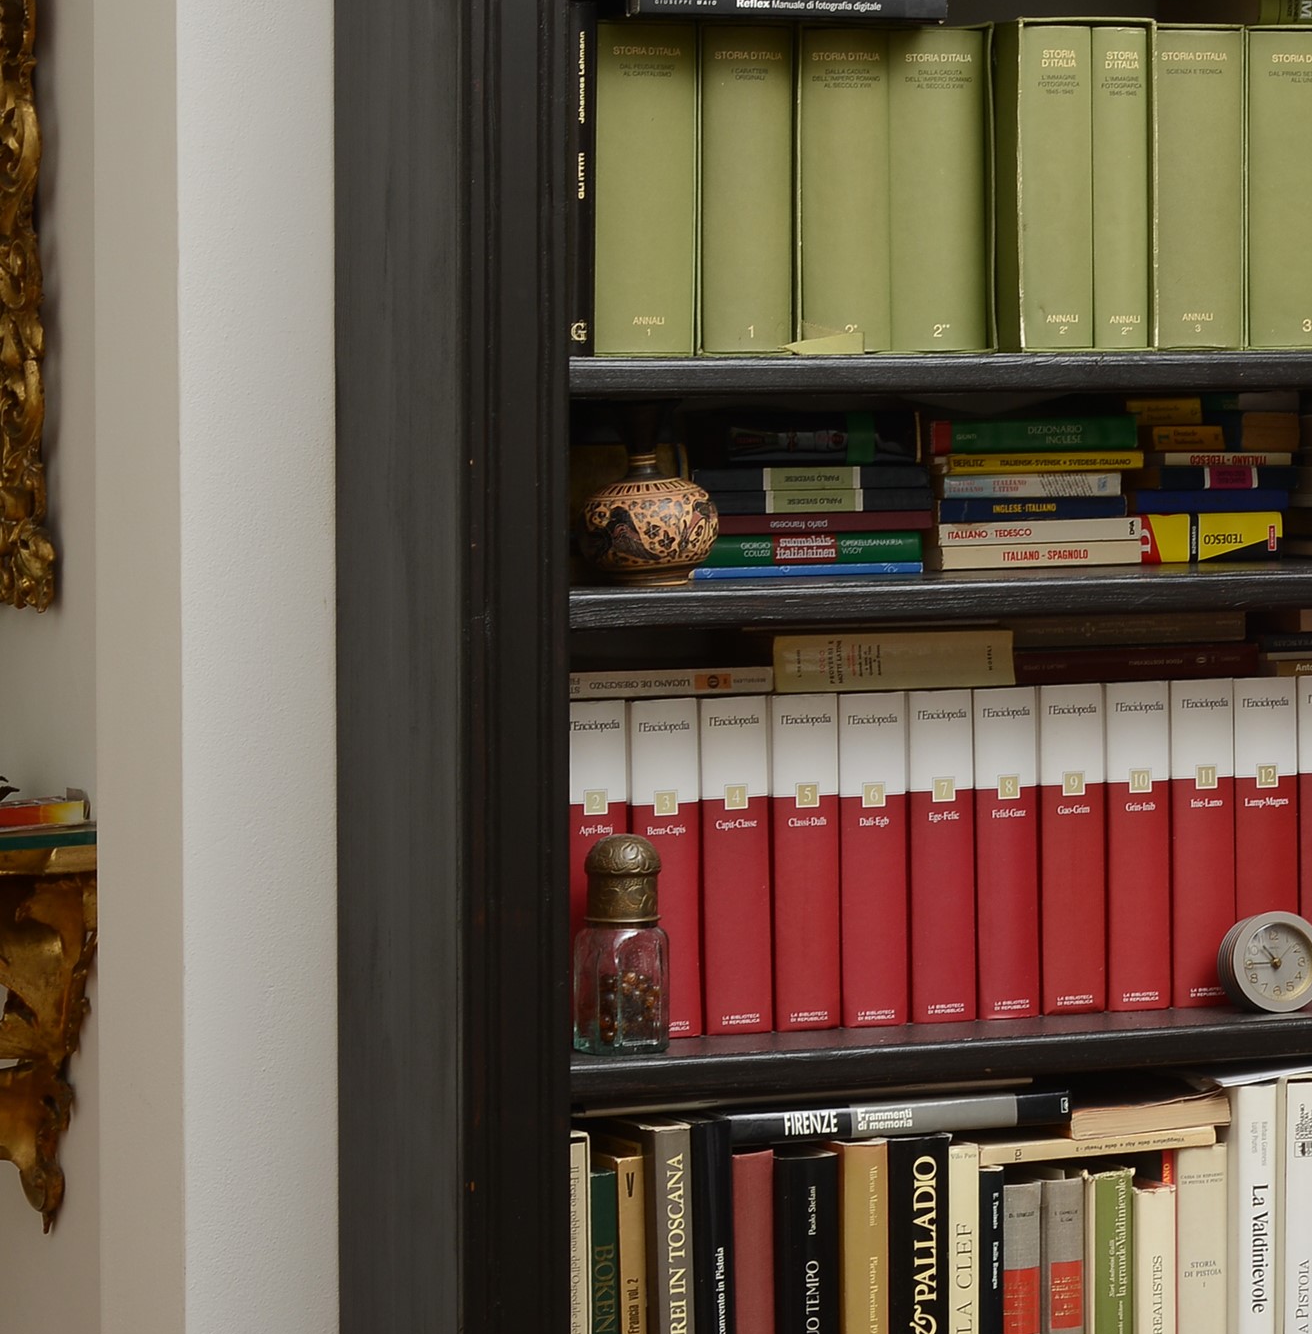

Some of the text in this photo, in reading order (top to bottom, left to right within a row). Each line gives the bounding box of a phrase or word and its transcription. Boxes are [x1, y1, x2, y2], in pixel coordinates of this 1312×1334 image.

[771, 0, 805, 10] Manuale
[806, 1, 814, 9] di
[815, 1, 852, 11] fotografia
[853, 1, 881, 12] digitale
[1271, 54, 1304, 64] STORIA
[948, 528, 1032, 540] ITALIANO TEDESCO
[1204, 534, 1244, 544] TEDESCO
[1002, 551, 1039, 562] ITALIANO
[1047, 549, 1089, 560] SPAGNOLO
[1260, 768, 1274, 782] 12
[803, 788, 811, 802] 5
[647, 825, 686, 836] Benn-Capis
[715, 819, 757, 829] Capit-Classe
[858, 1109, 912, 1121] Frammenti
[784, 1111, 838, 1136] FIRENZE
[858, 1118, 913, 1131] di memoria
[667, 1153, 687, 1263] TOSCANA
[956, 1222, 972, 1289] CLEF
[1251, 1184, 1269, 1314] La Valdinievole
[669, 1267, 688, 1297] IN
[956, 1301, 972, 1334] LA
